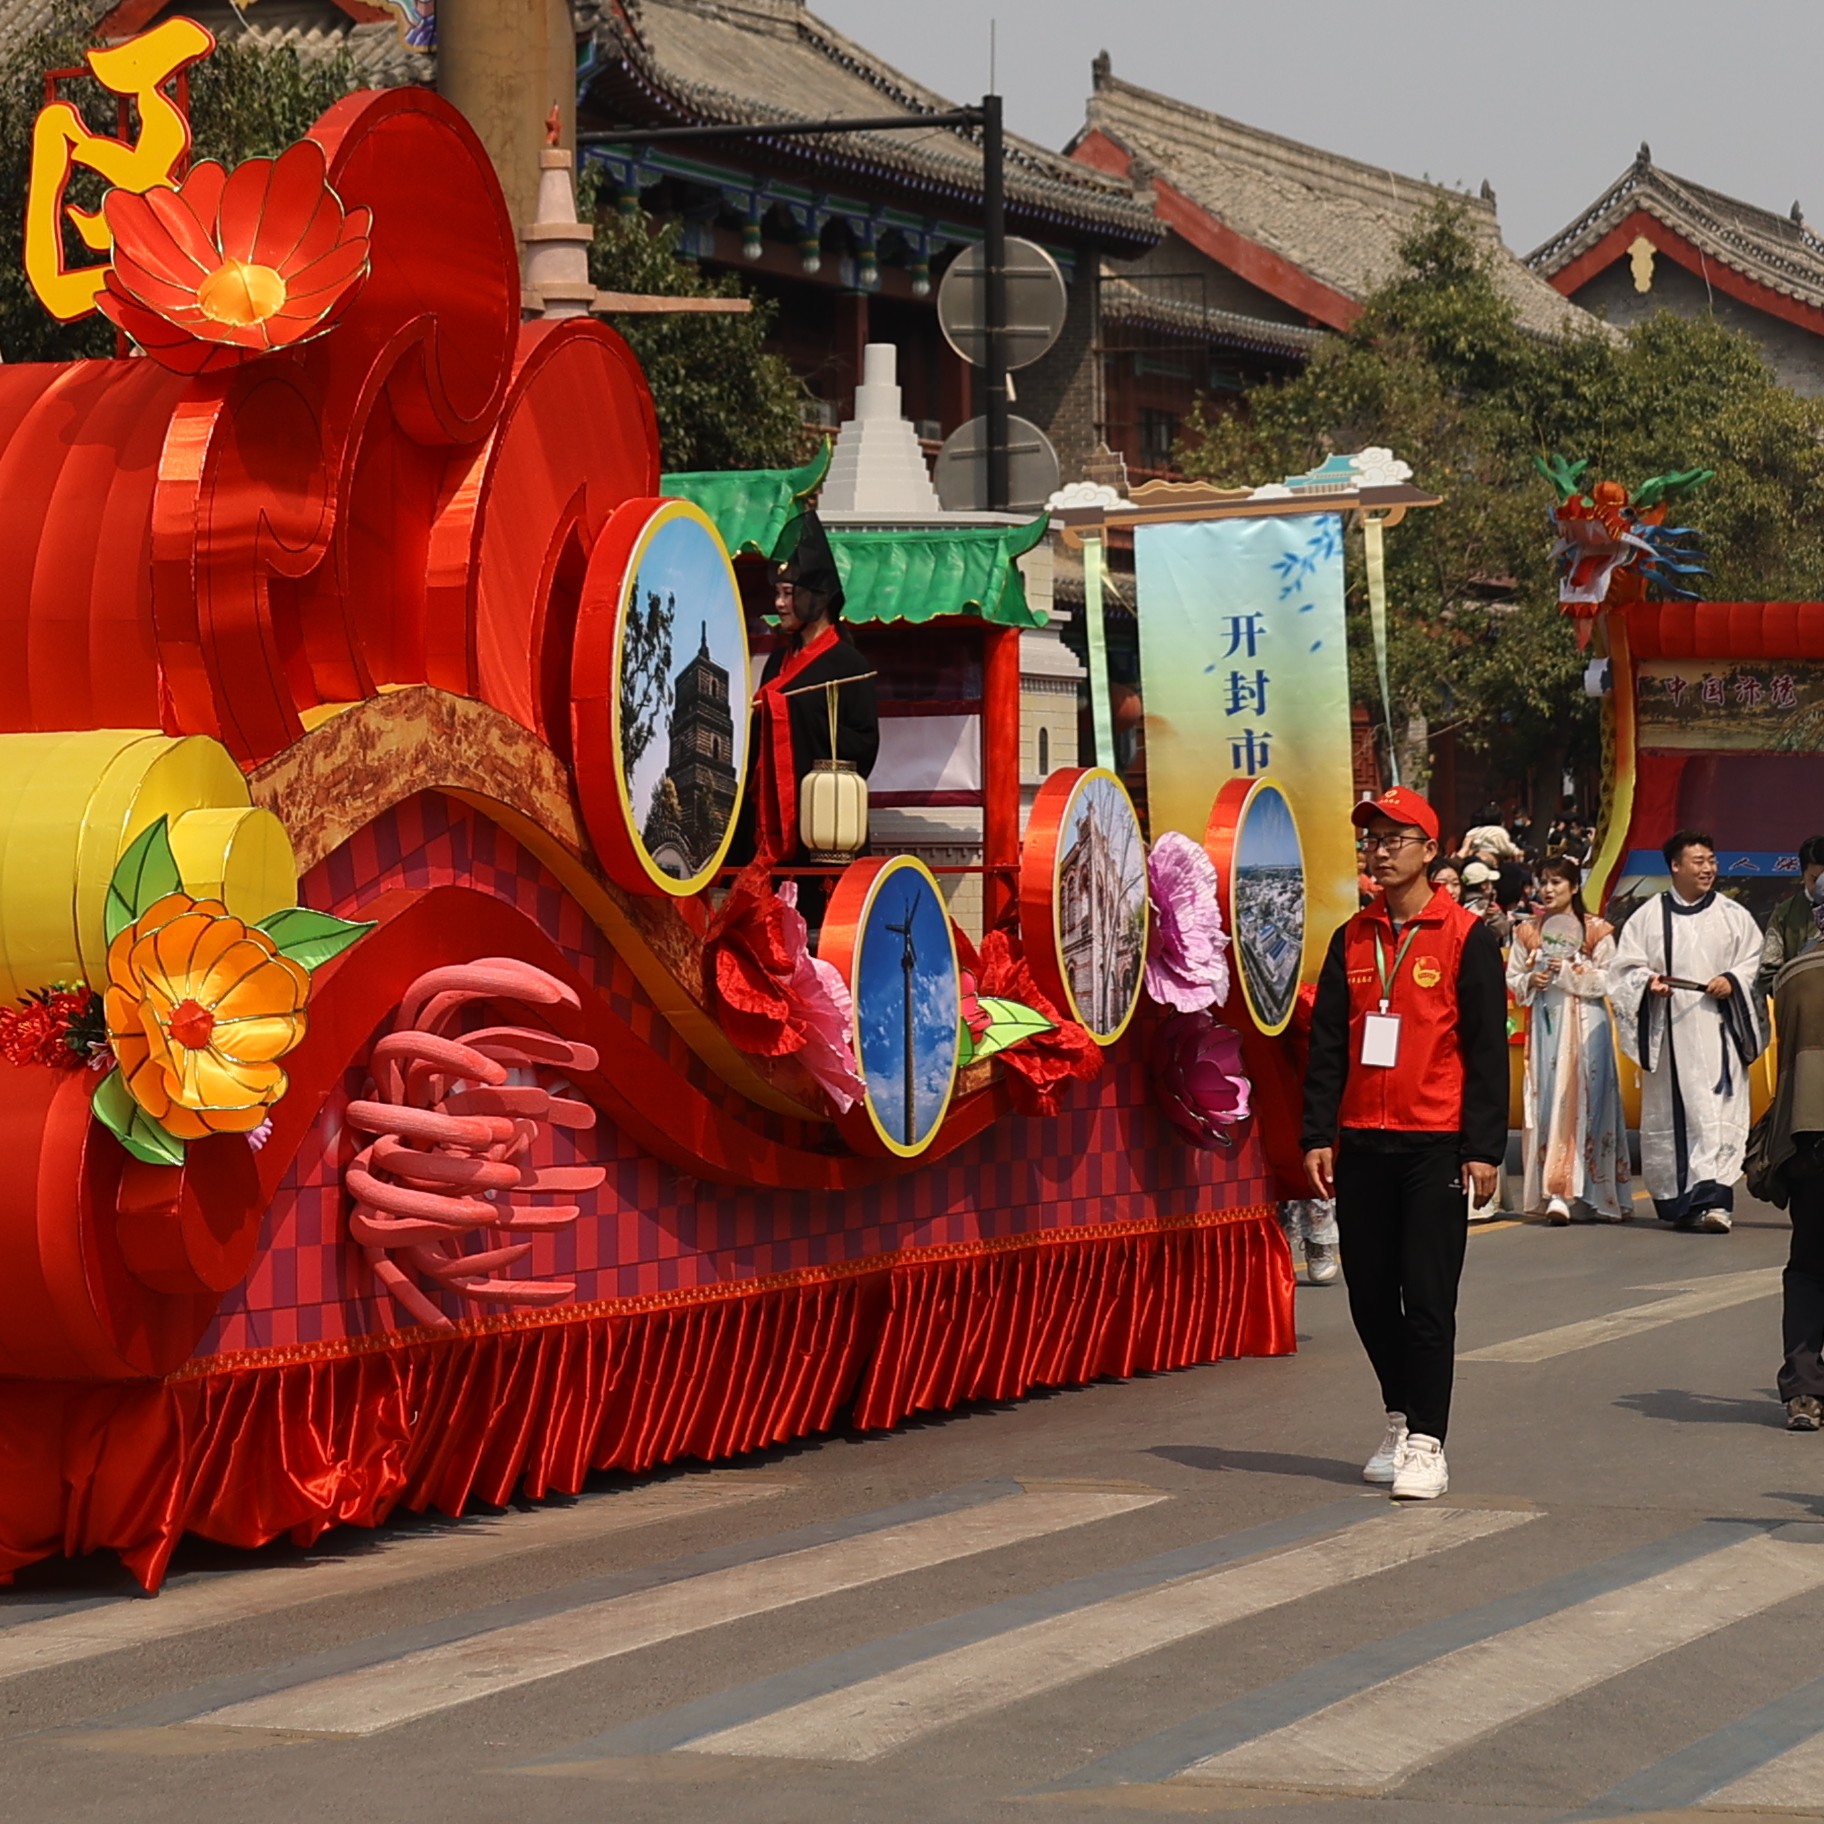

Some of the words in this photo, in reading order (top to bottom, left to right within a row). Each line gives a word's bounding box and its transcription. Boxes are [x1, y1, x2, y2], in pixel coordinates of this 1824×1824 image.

[1220, 611, 1272, 778] 开封市
[1664, 674, 1799, 709] 中国汴绣
